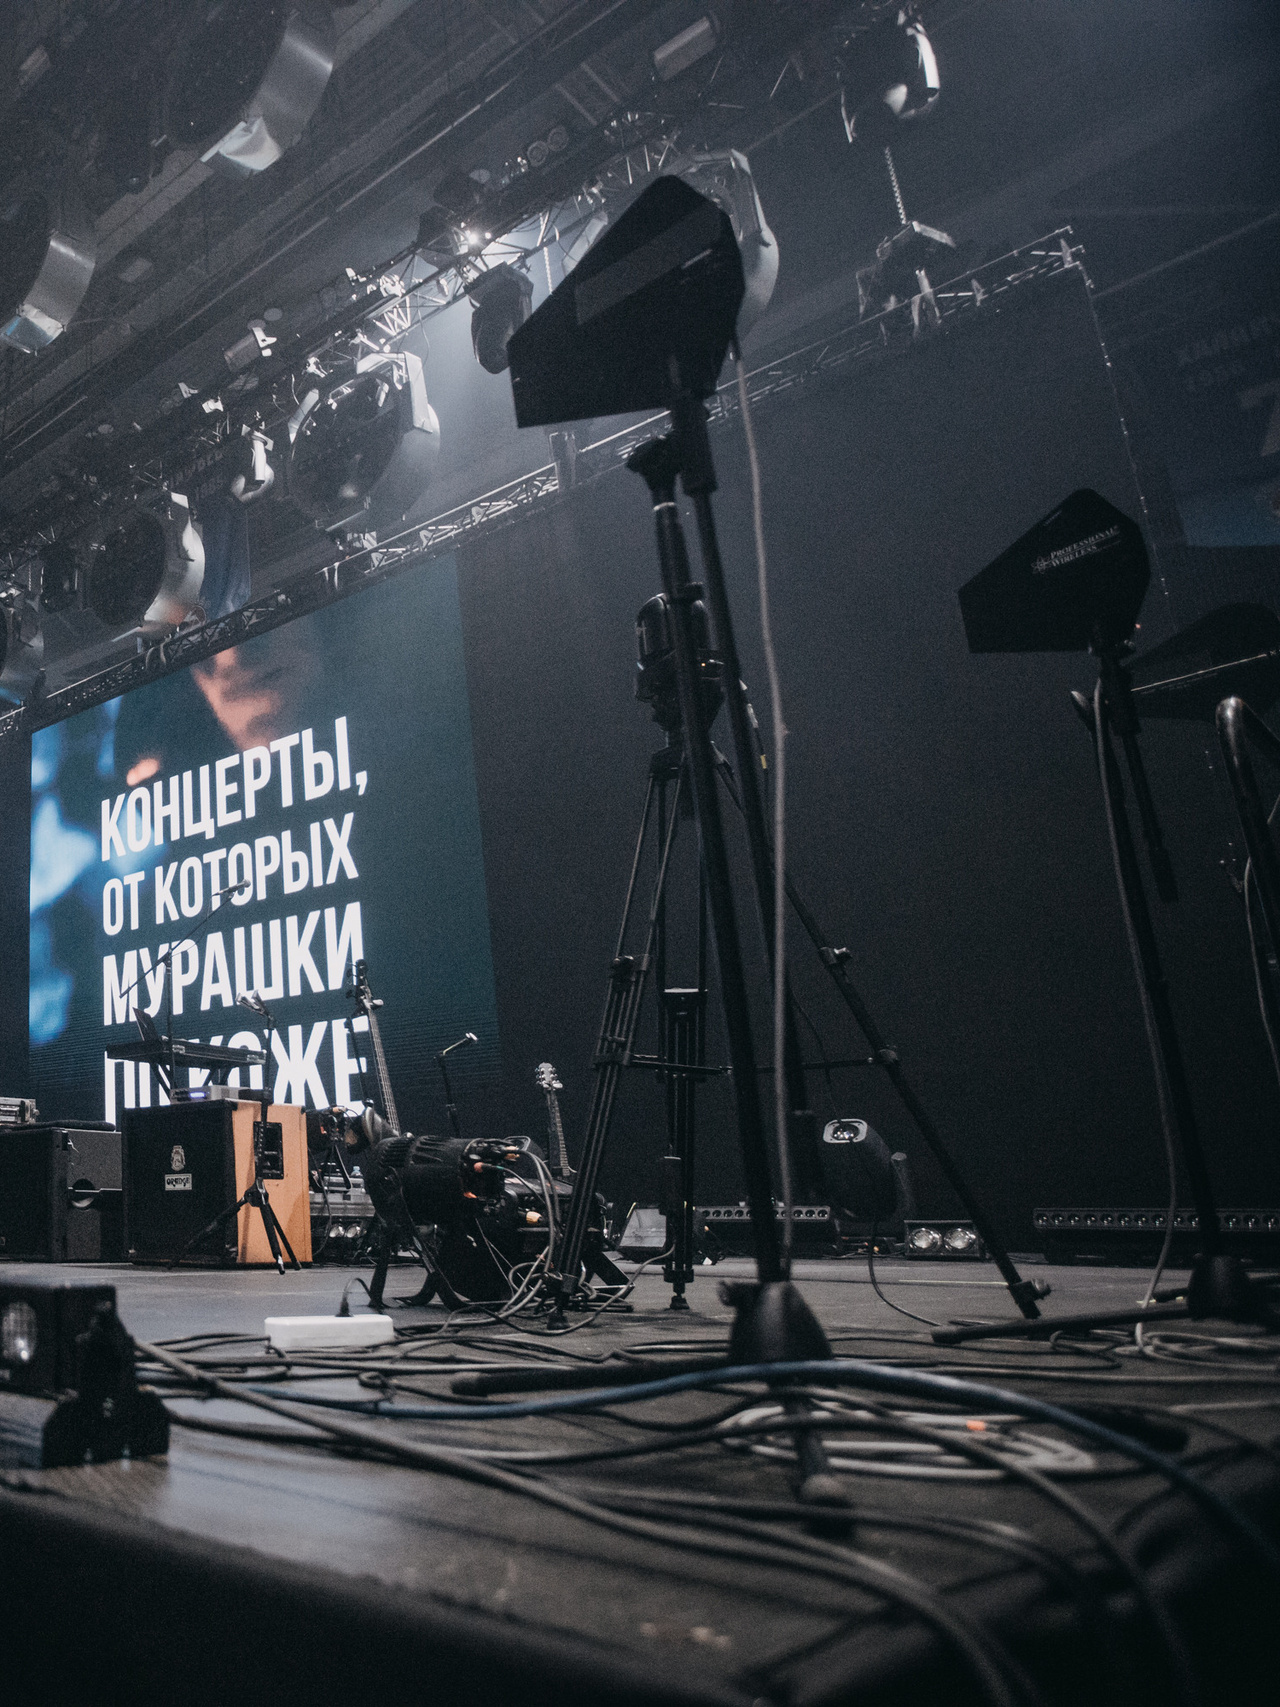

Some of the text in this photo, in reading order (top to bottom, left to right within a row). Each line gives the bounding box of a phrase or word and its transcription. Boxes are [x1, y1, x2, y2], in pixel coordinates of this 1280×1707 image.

[101, 716, 368, 861] КОНЦЕРТЫ,
[103, 812, 359, 936] ОТ КОТОРЫХ
[103, 901, 365, 1026] МУРАШКИ
